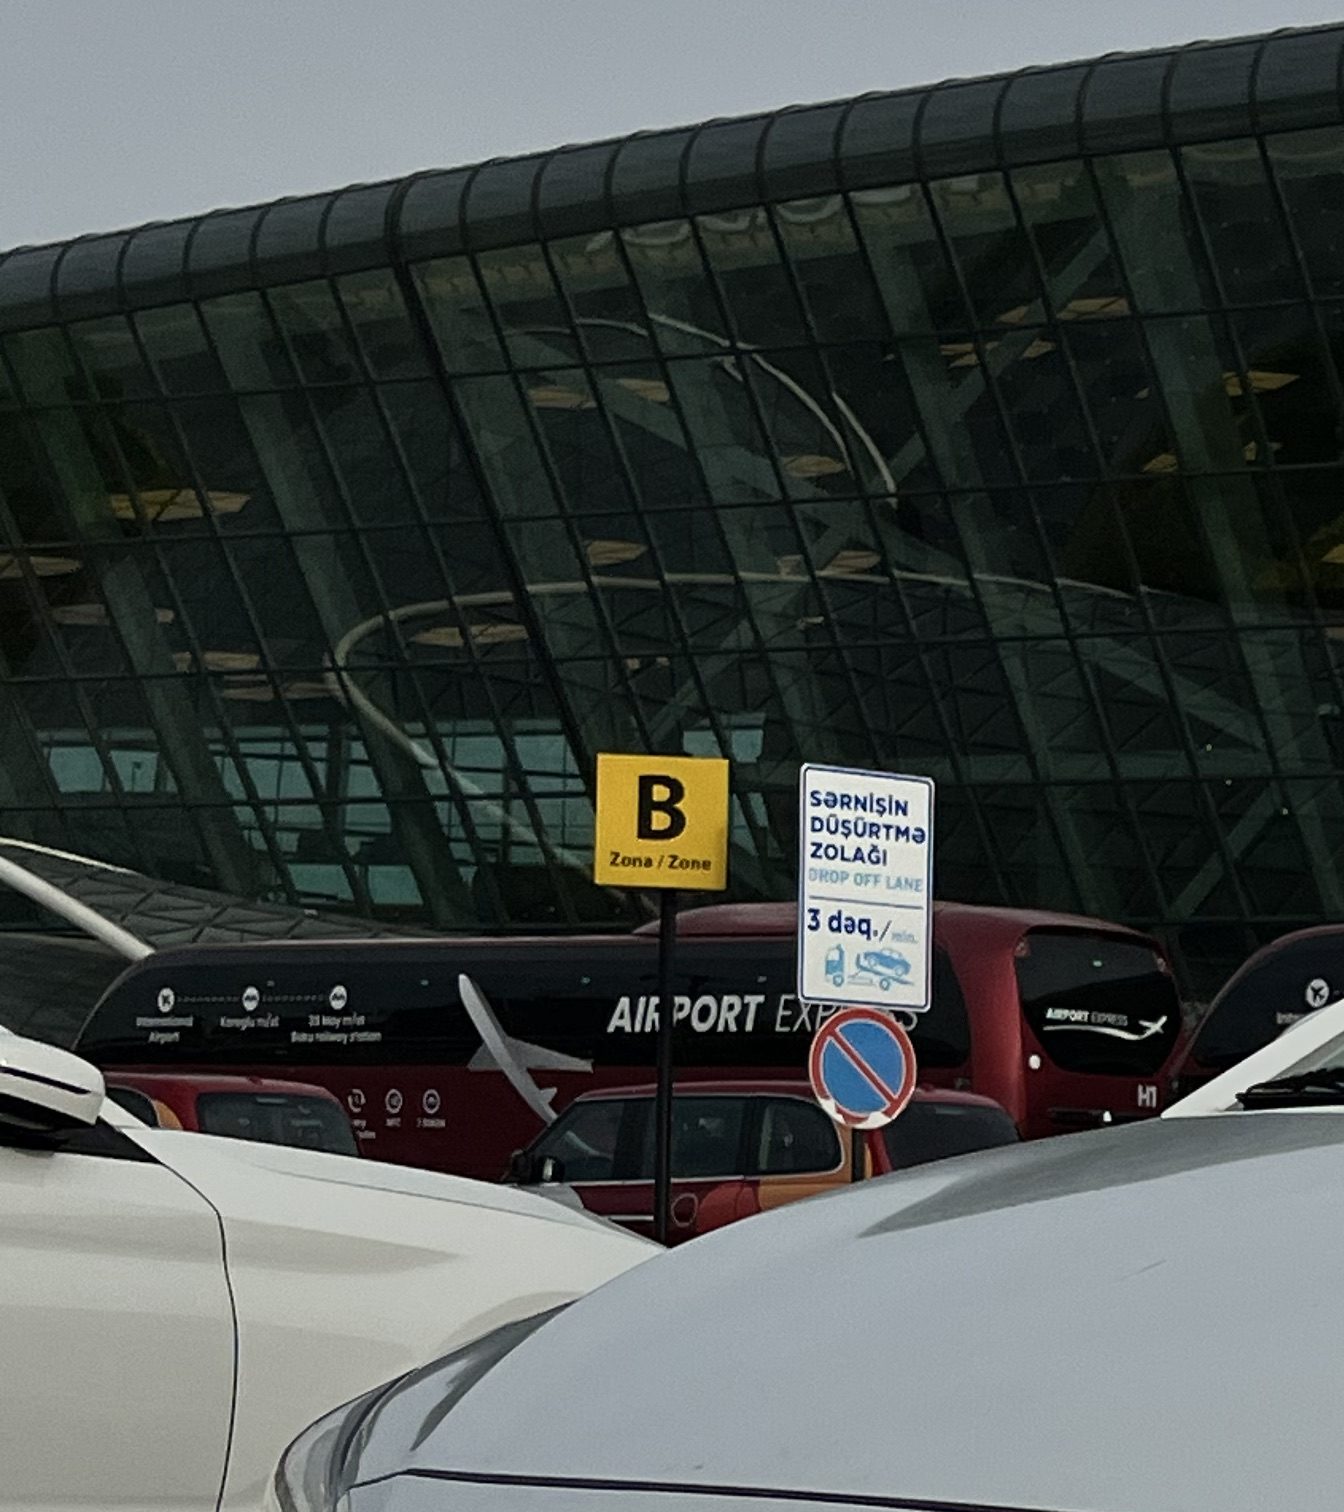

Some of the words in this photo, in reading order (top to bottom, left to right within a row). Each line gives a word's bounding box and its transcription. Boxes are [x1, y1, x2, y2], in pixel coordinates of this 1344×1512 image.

[637, 774, 686, 841] B
[810, 789, 909, 818] SƏRNİŞİN
[810, 813, 926, 845] DÜŞÜRTMƏ
[609, 851, 653, 869] Zona
[656, 854, 665, 870] /
[668, 854, 712, 872] Zone
[810, 842, 887, 867] ZOLAĞI
[808, 868, 849, 884] DROP
[853, 872, 882, 887] OFF
[886, 876, 923, 893] LANE
[807, 908, 820, 931] 3
